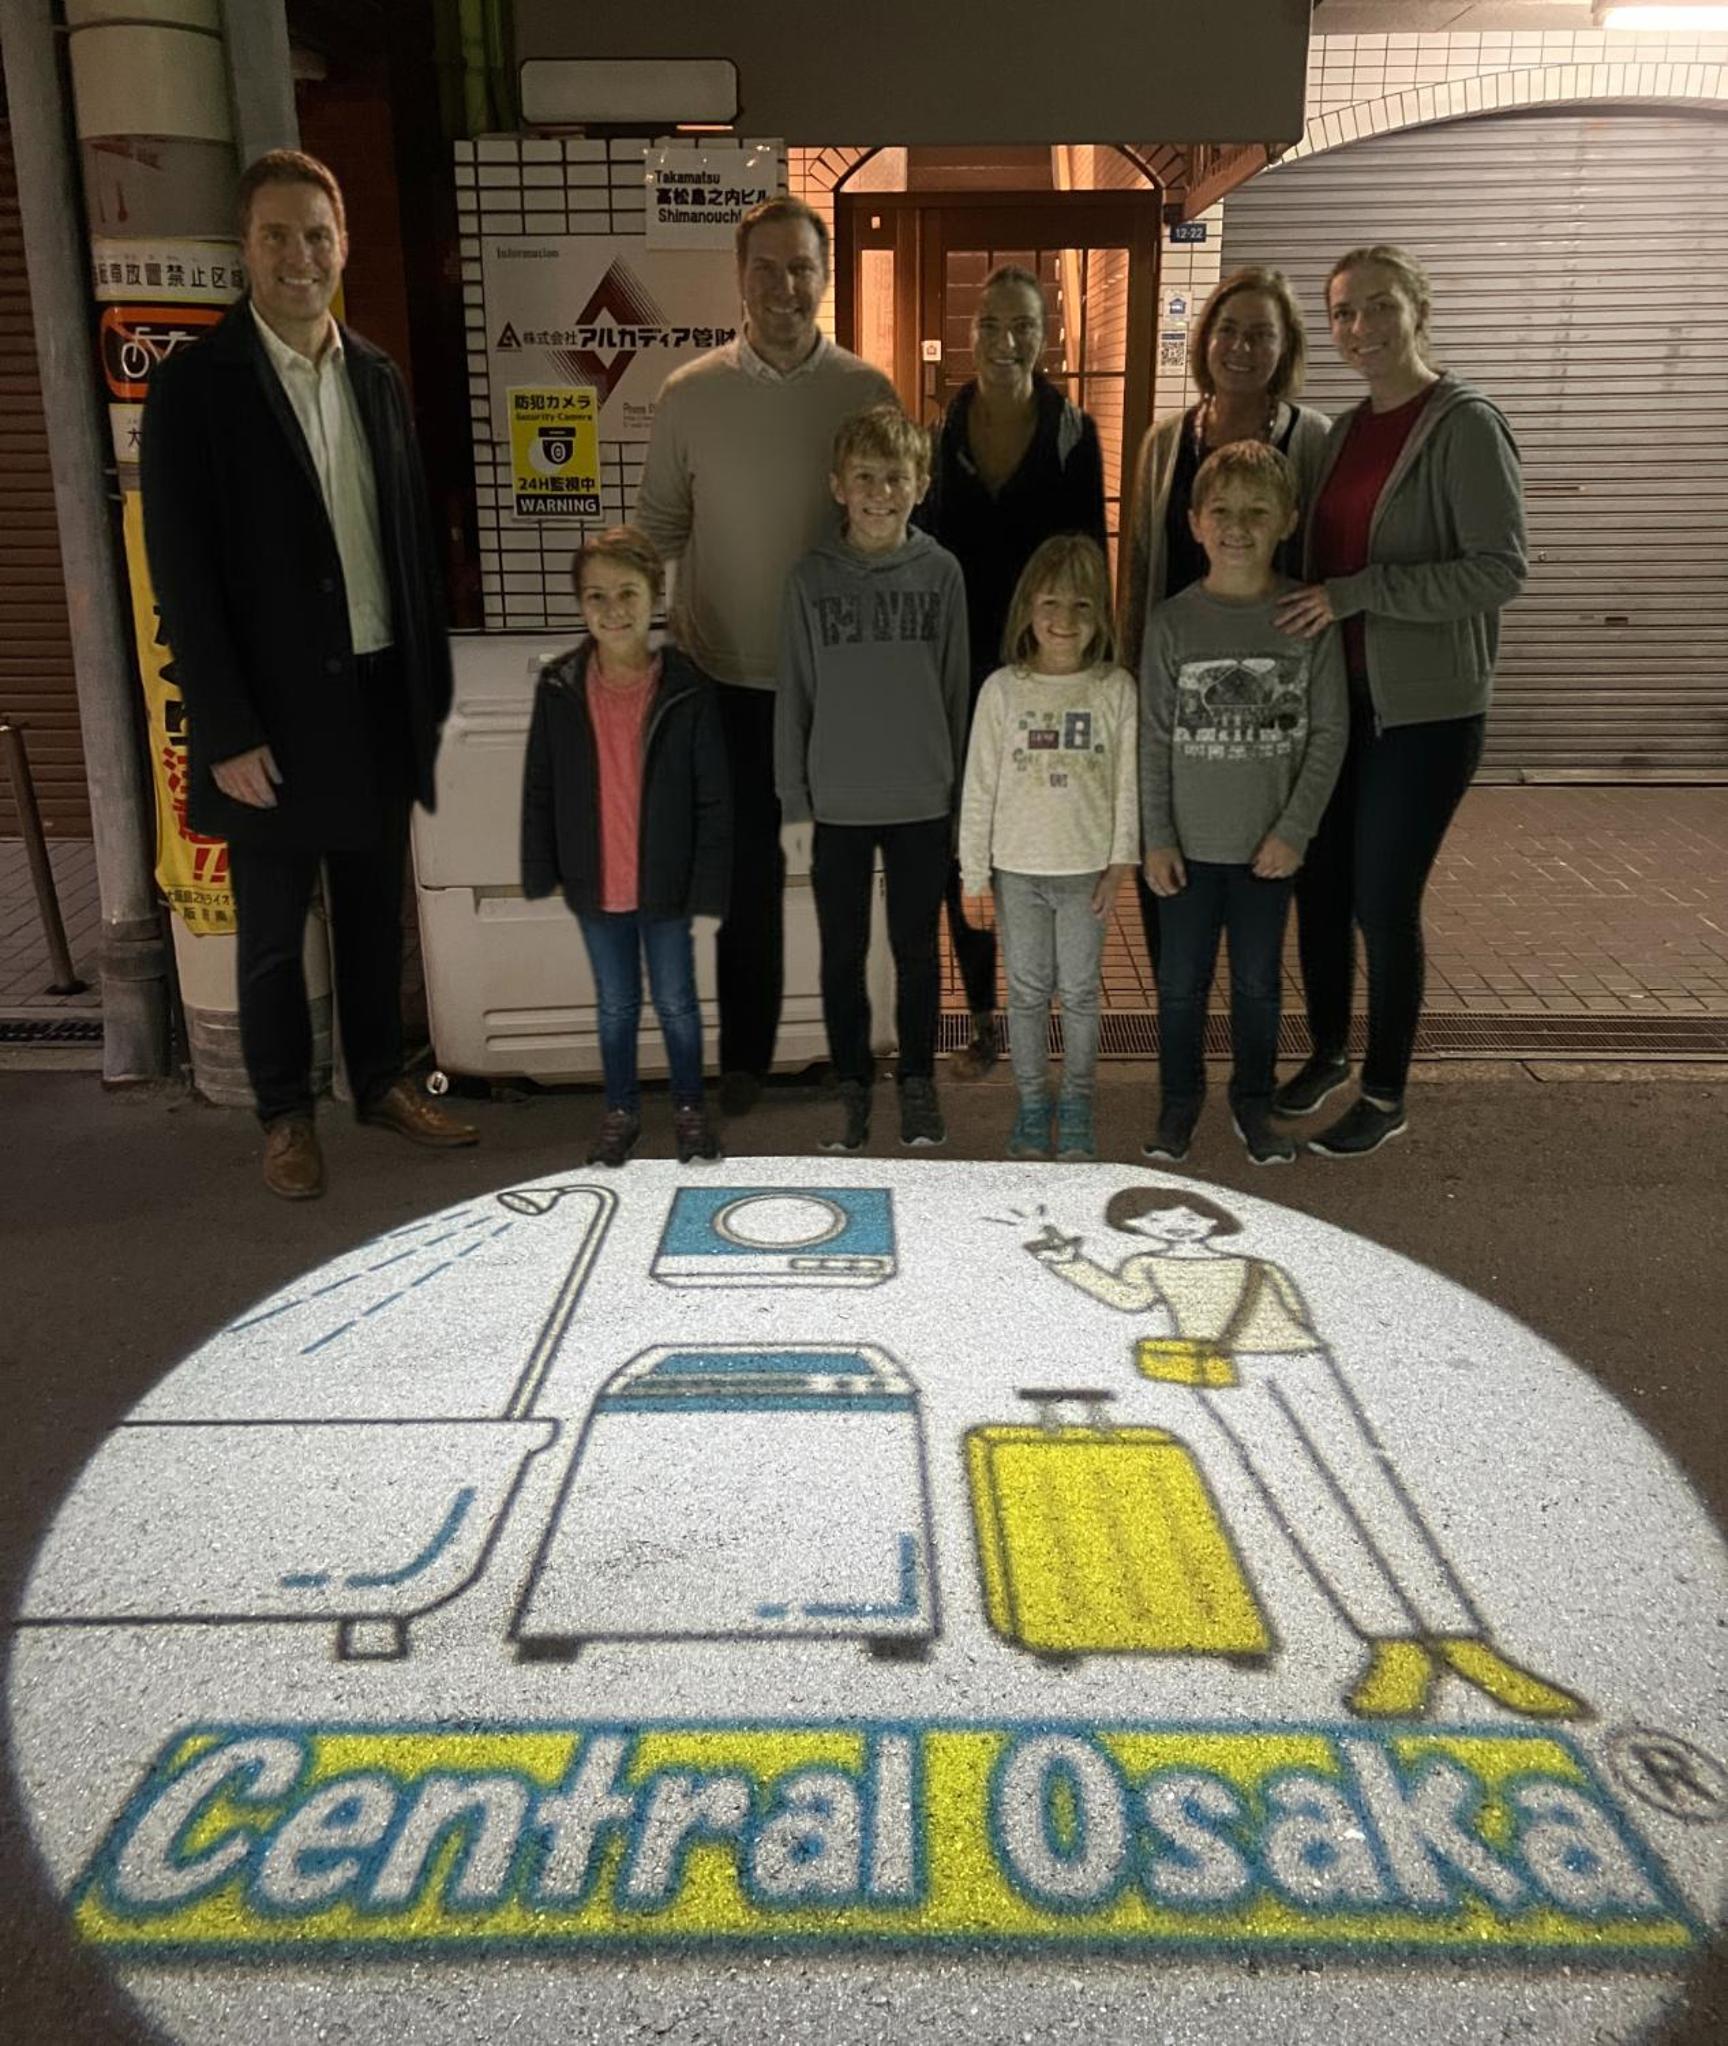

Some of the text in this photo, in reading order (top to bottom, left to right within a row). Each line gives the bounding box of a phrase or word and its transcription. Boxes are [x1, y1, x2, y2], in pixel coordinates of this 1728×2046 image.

[655, 170, 720, 184] Takamatsu
[656, 188, 767, 206] 高松島之内ビル
[1175, 227, 1203, 239] 12-22
[496, 247, 559, 259] Information
[515, 395, 590, 410] 防犯カメラ
[518, 477, 595, 492] 24H監視中
[520, 498, 597, 513] WARNING
[112, 1728, 918, 1907] Central
[998, 1730, 1668, 1907] Osaka
